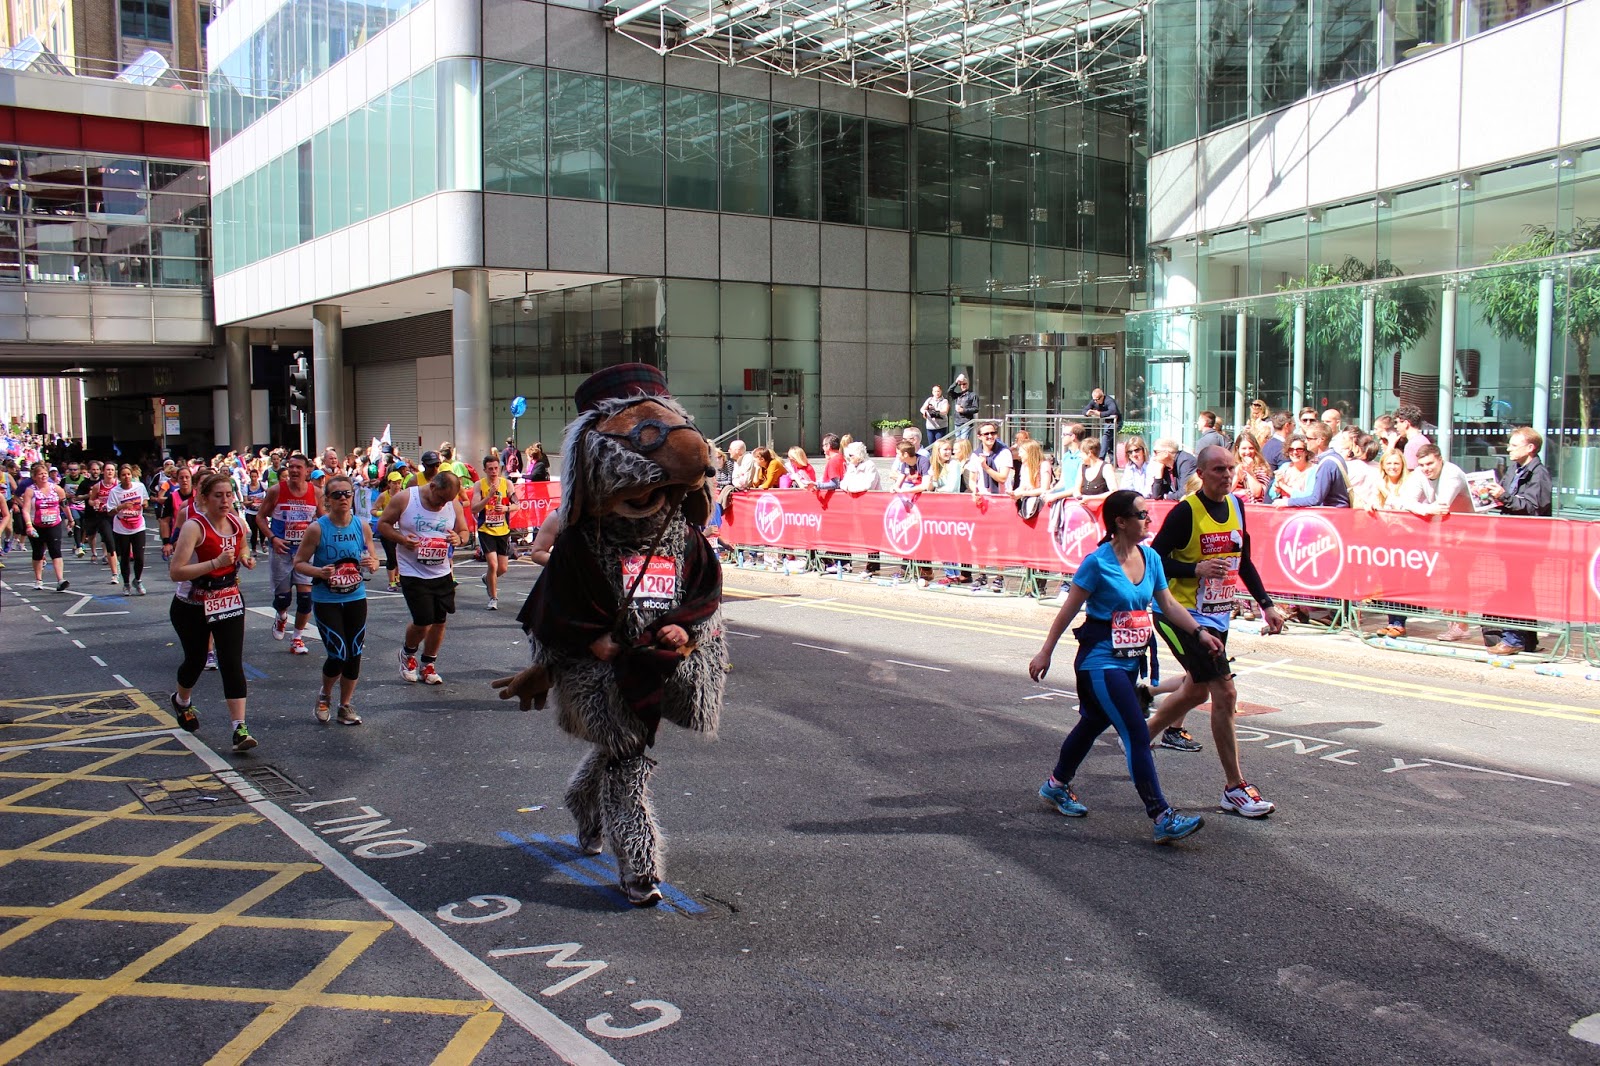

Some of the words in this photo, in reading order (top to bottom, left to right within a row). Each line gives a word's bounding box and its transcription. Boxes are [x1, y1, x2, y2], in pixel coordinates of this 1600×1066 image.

[759, 500, 782, 535] Virgin
[785, 512, 822, 532] money
[888, 497, 921, 545] Virgin
[923, 520, 975, 542] money
[219, 536, 237, 548] JEN
[333, 533, 357, 542] TEAM
[1201, 534, 1230, 544] children
[420, 549, 447, 558] 45746
[1202, 546, 1223, 554] cancer
[1284, 522, 1337, 578] Virgin
[1347, 545, 1439, 577] money
[647, 562, 674, 570] money
[626, 575, 674, 595] 41202
[206, 595, 241, 612] 35474
[218, 609, 244, 621] #boost
[1114, 628, 1150, 645] 33591
[1234, 729, 1431, 774] ONLY
[290, 797, 427, 858] ONLY
